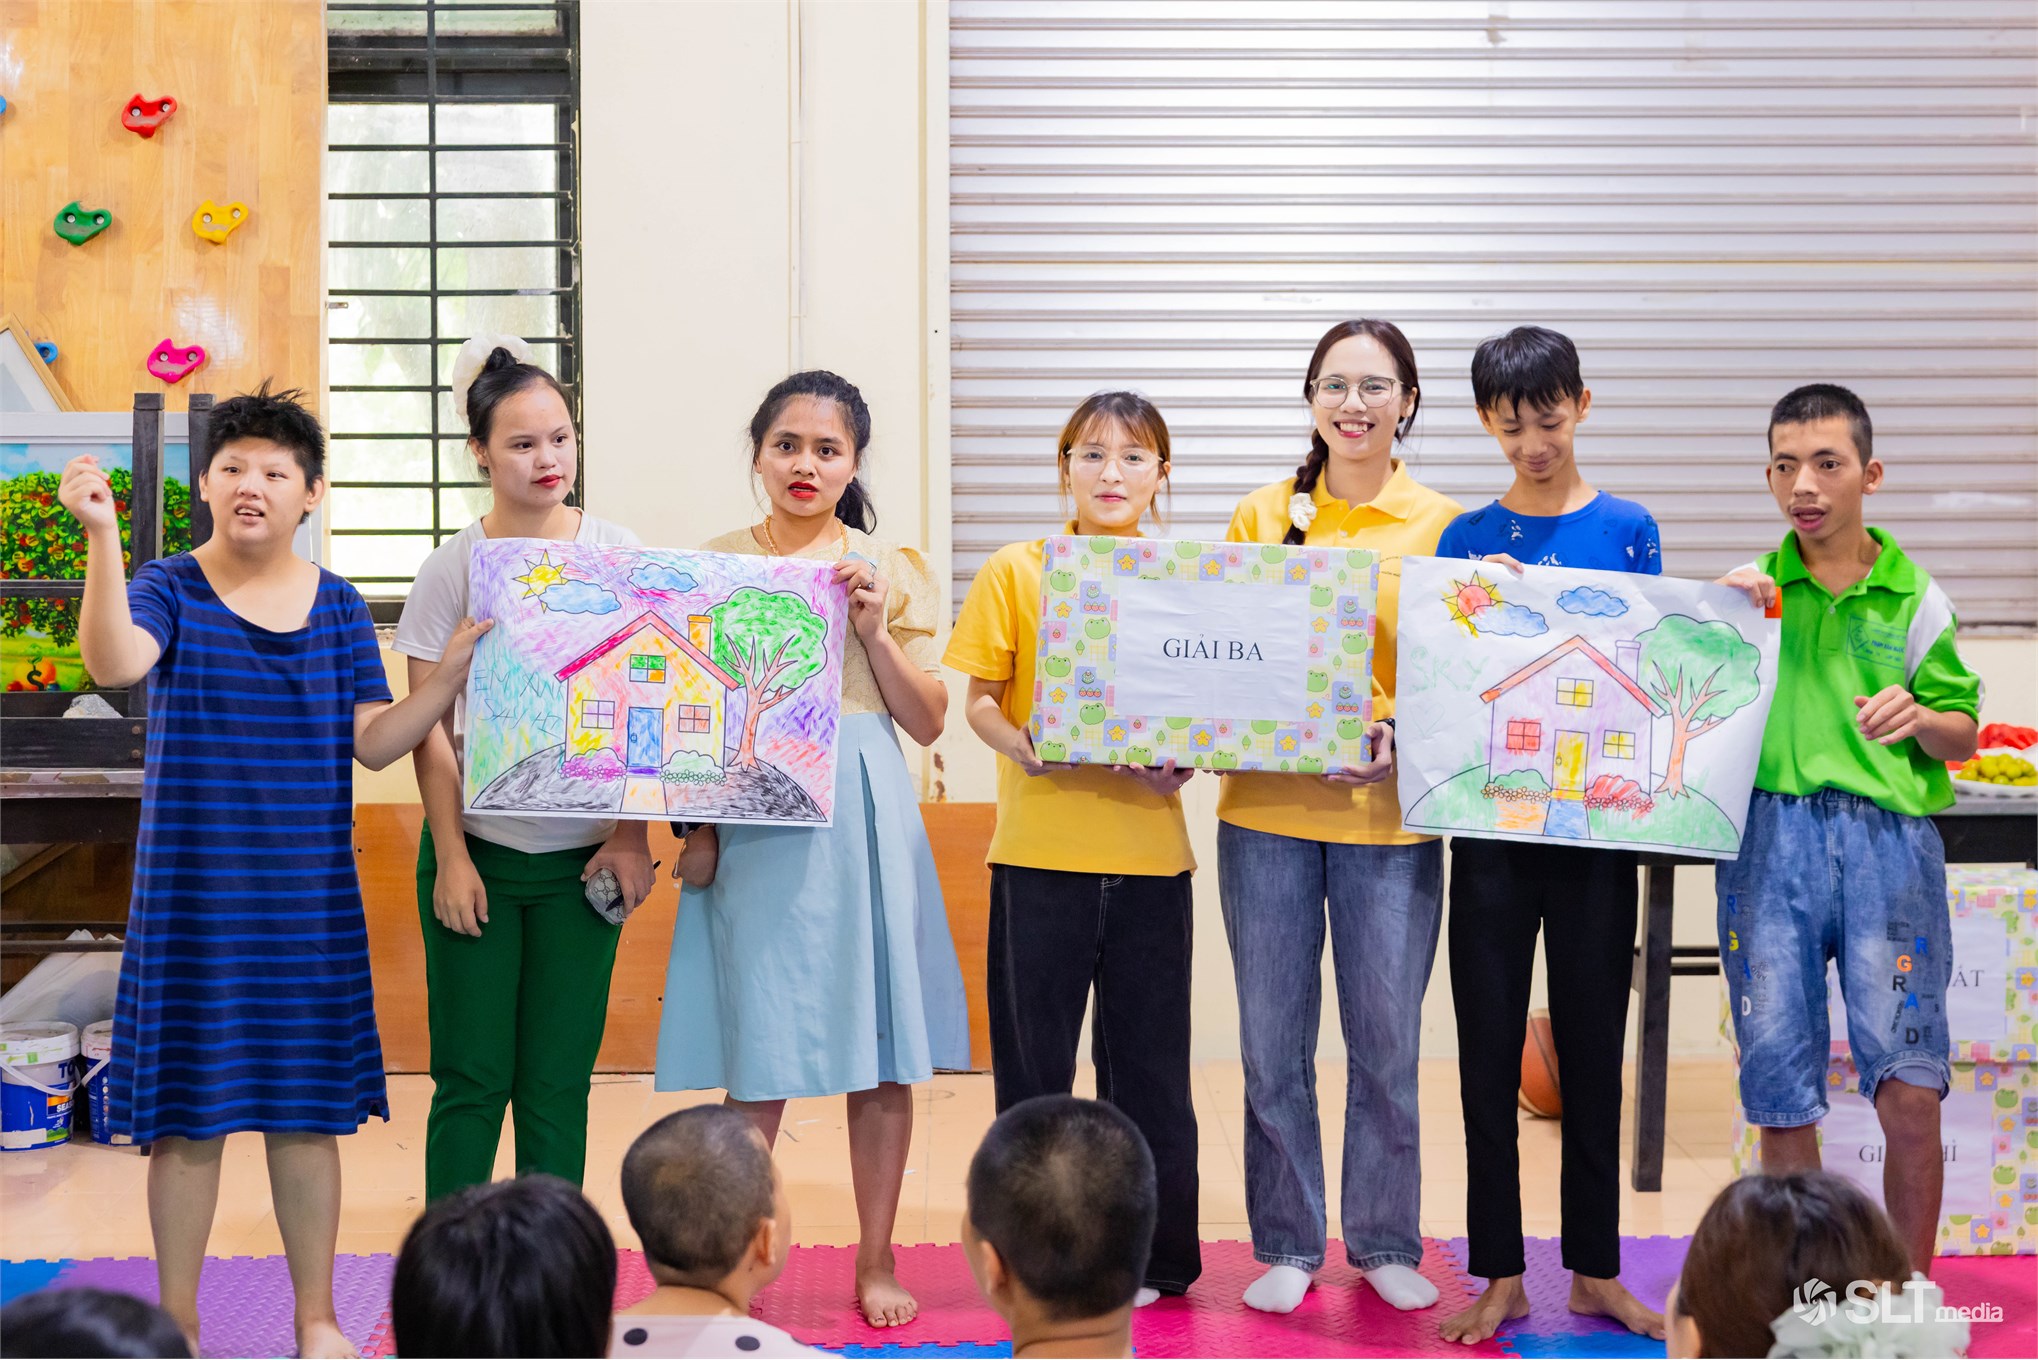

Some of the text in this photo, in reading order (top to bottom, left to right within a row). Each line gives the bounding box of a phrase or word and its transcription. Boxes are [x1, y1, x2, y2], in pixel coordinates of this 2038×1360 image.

[1163, 633, 1264, 661] GIẢI BA
[1896, 954, 1913, 973] G
[1892, 974, 1907, 993] R
[1905, 1027, 1920, 1045] D
